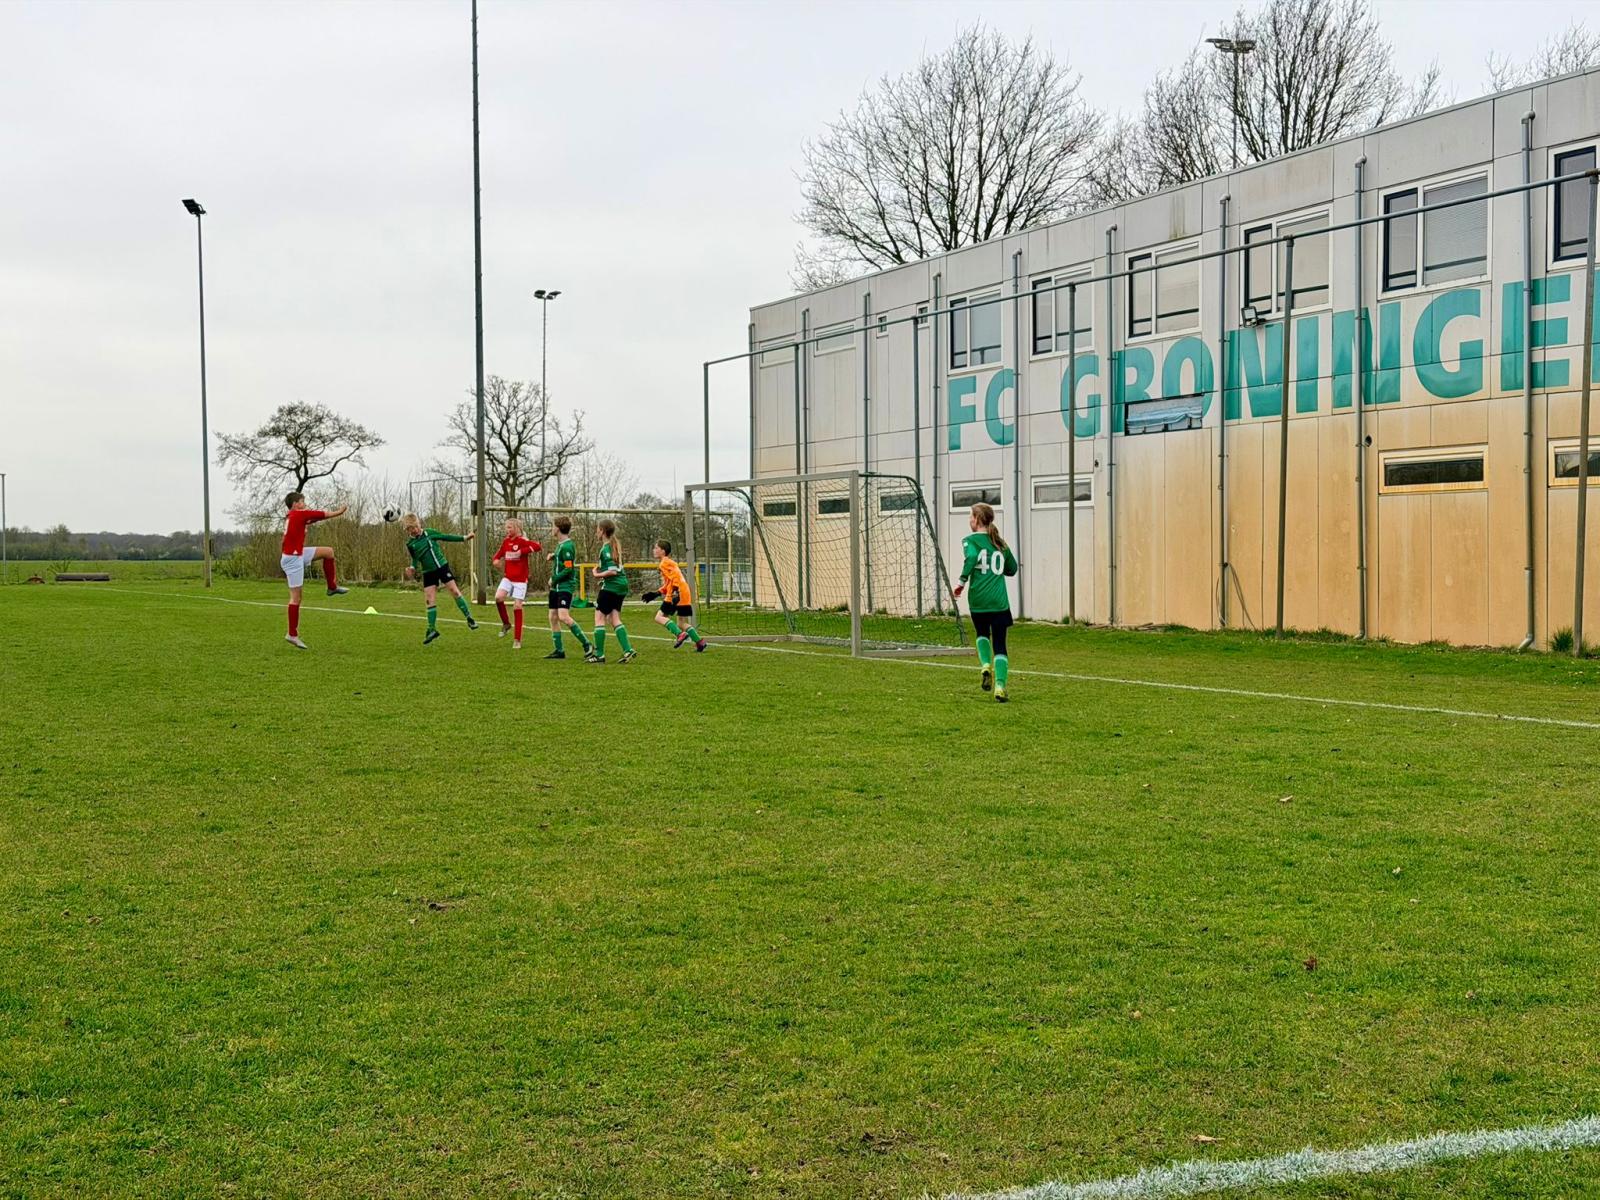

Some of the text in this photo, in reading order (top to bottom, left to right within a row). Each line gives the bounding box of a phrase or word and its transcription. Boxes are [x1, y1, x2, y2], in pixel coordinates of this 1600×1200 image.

[948, 268, 1600, 450] FC GRONINGE
[975, 549, 1005, 576] 40
